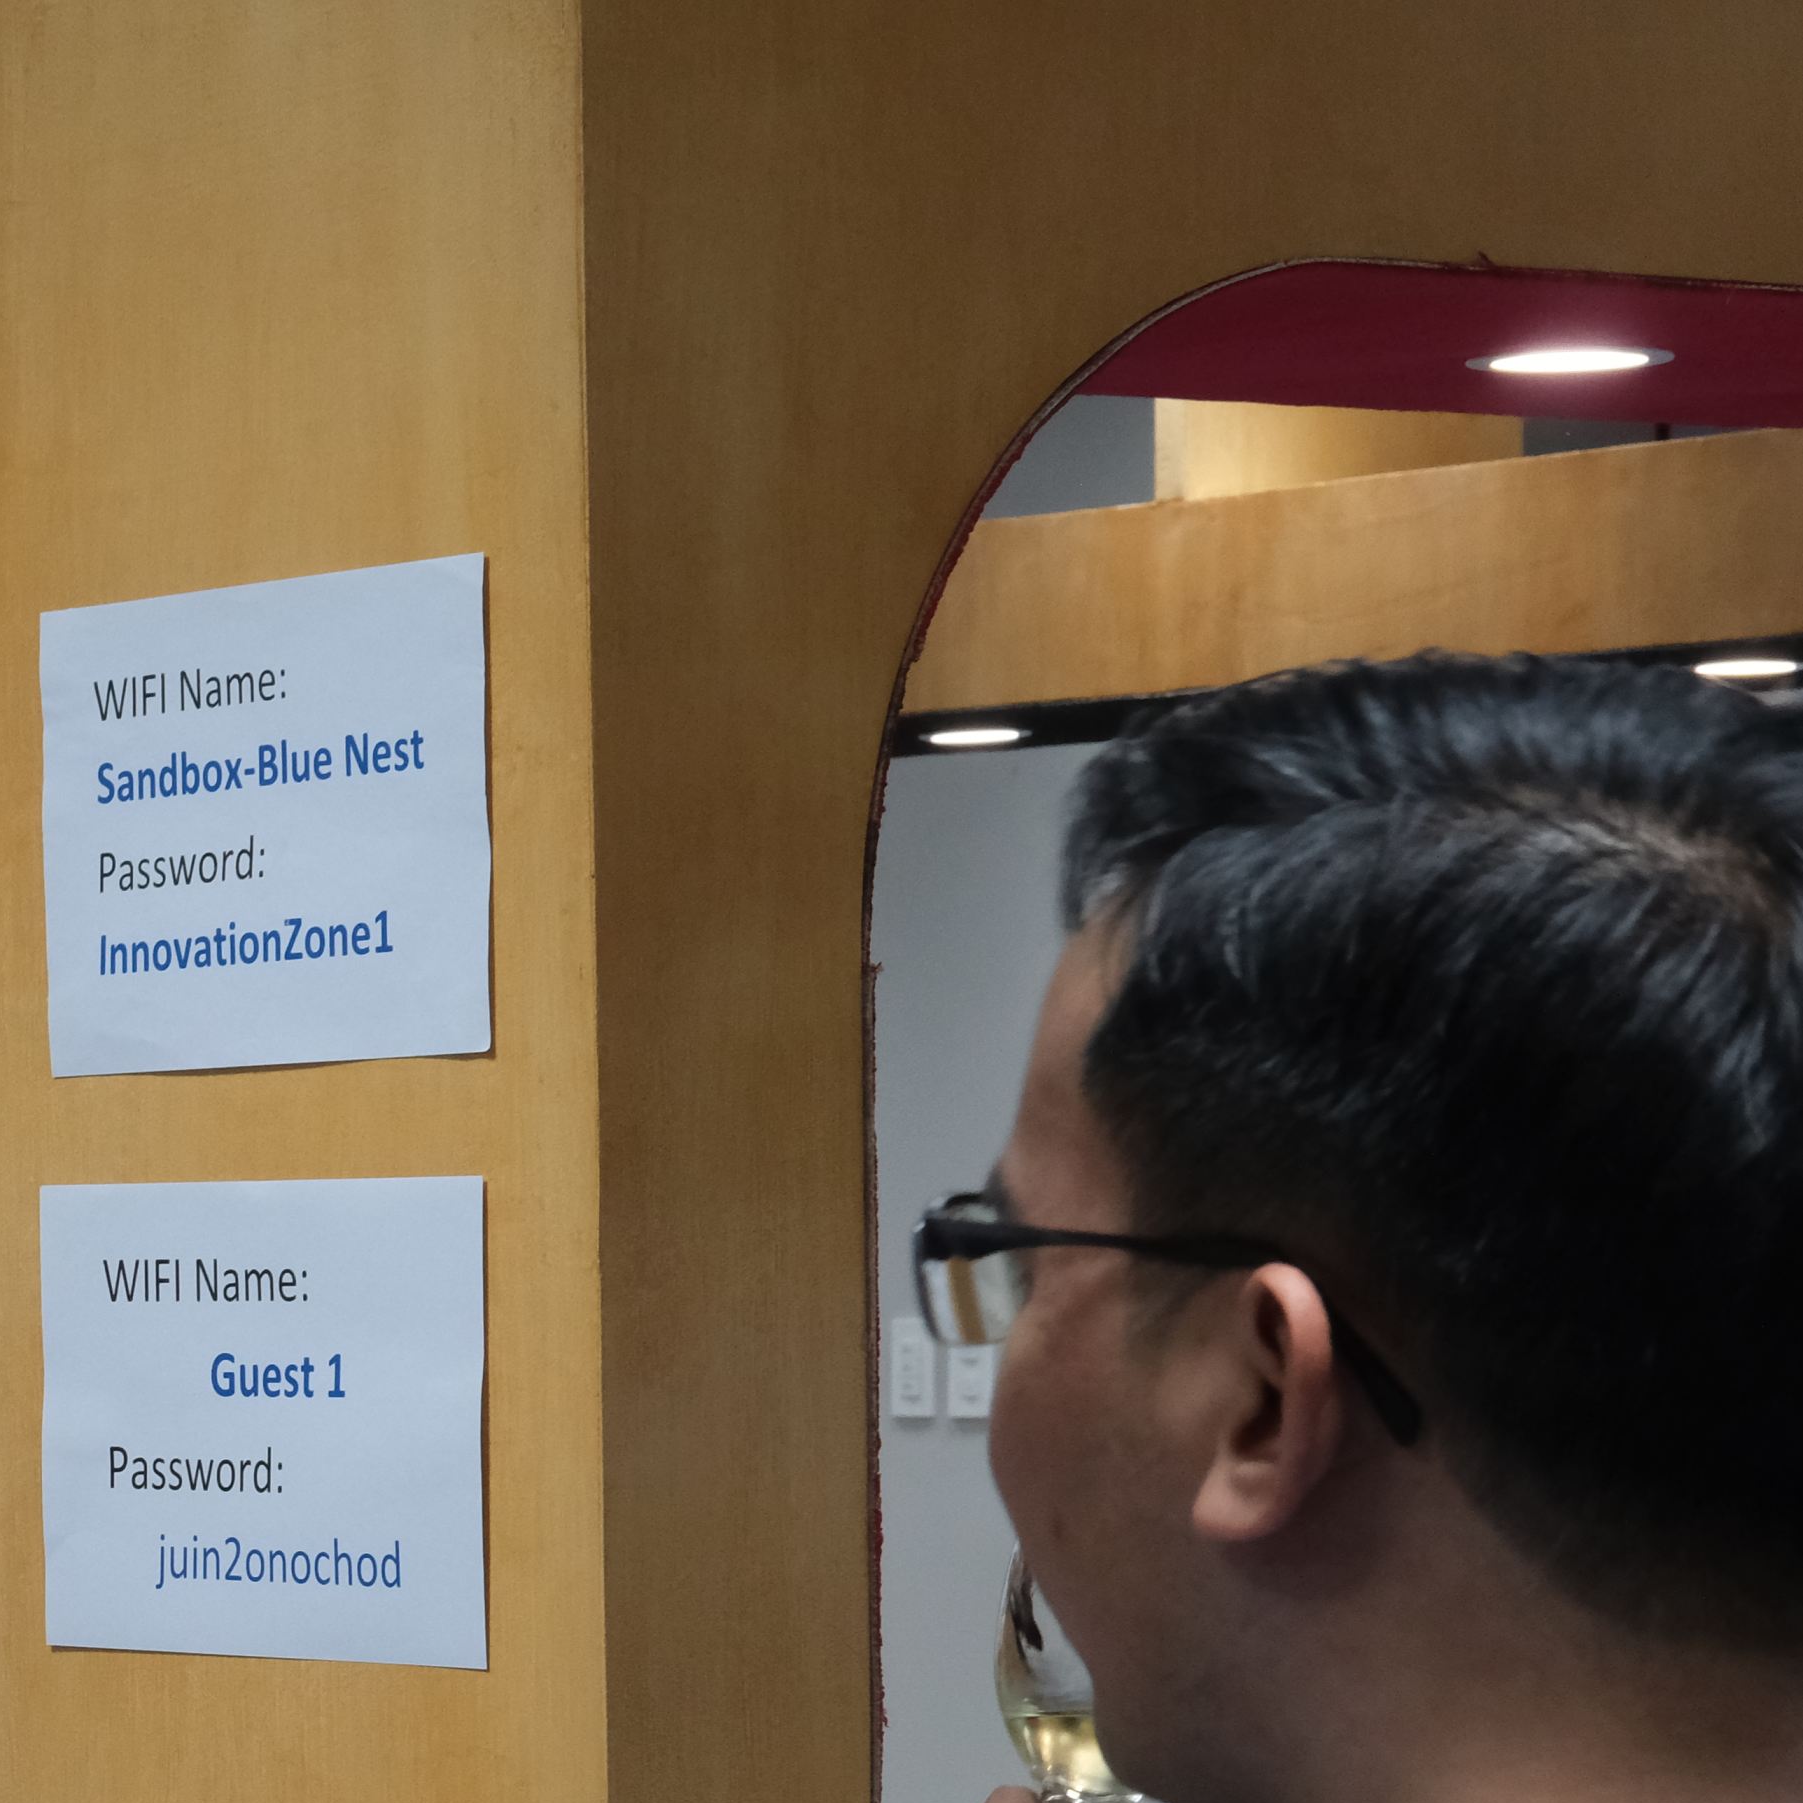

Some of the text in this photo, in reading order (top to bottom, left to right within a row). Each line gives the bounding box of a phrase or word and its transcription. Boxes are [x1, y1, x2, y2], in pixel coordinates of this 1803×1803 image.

[94, 668, 287, 721] WIFI Name:
[97, 729, 425, 804] Sandbox-Blue Nest
[99, 834, 265, 893] Password:
[99, 910, 394, 976] InnovationZone1
[103, 1259, 309, 1302] WIFI Name:
[210, 1352, 346, 1398] Guest 1
[109, 1446, 283, 1493] Password:
[156, 1534, 402, 1589] juin2onochod
